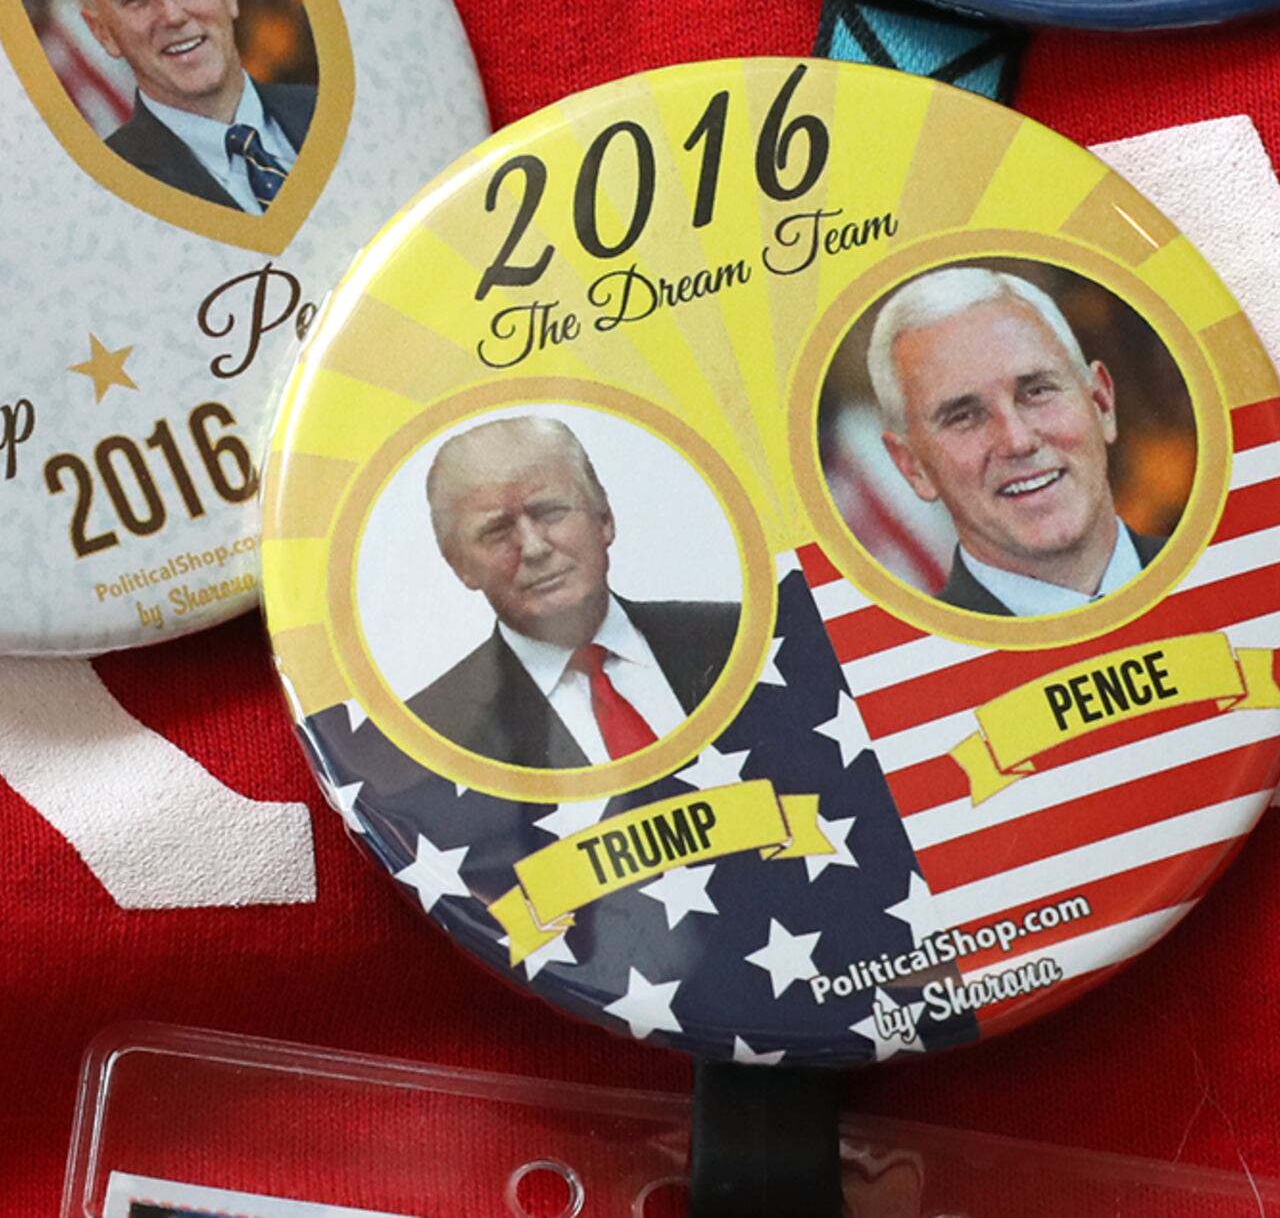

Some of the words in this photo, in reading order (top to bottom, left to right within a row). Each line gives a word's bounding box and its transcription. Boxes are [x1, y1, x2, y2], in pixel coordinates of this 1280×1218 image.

[474, 63, 831, 302] 2016
[476, 298, 582, 369] The
[587, 262, 753, 333] Dream
[761, 207, 899, 276] Team
[41, 399, 260, 561] 2016
[135, 600, 166, 631] by
[1044, 650, 1179, 735] PENCE
[575, 800, 718, 889] TRUMP
[808, 894, 1092, 1006] PoliticalShop.com
[872, 998, 918, 1045] by
[921, 957, 1063, 1023] Sharona
